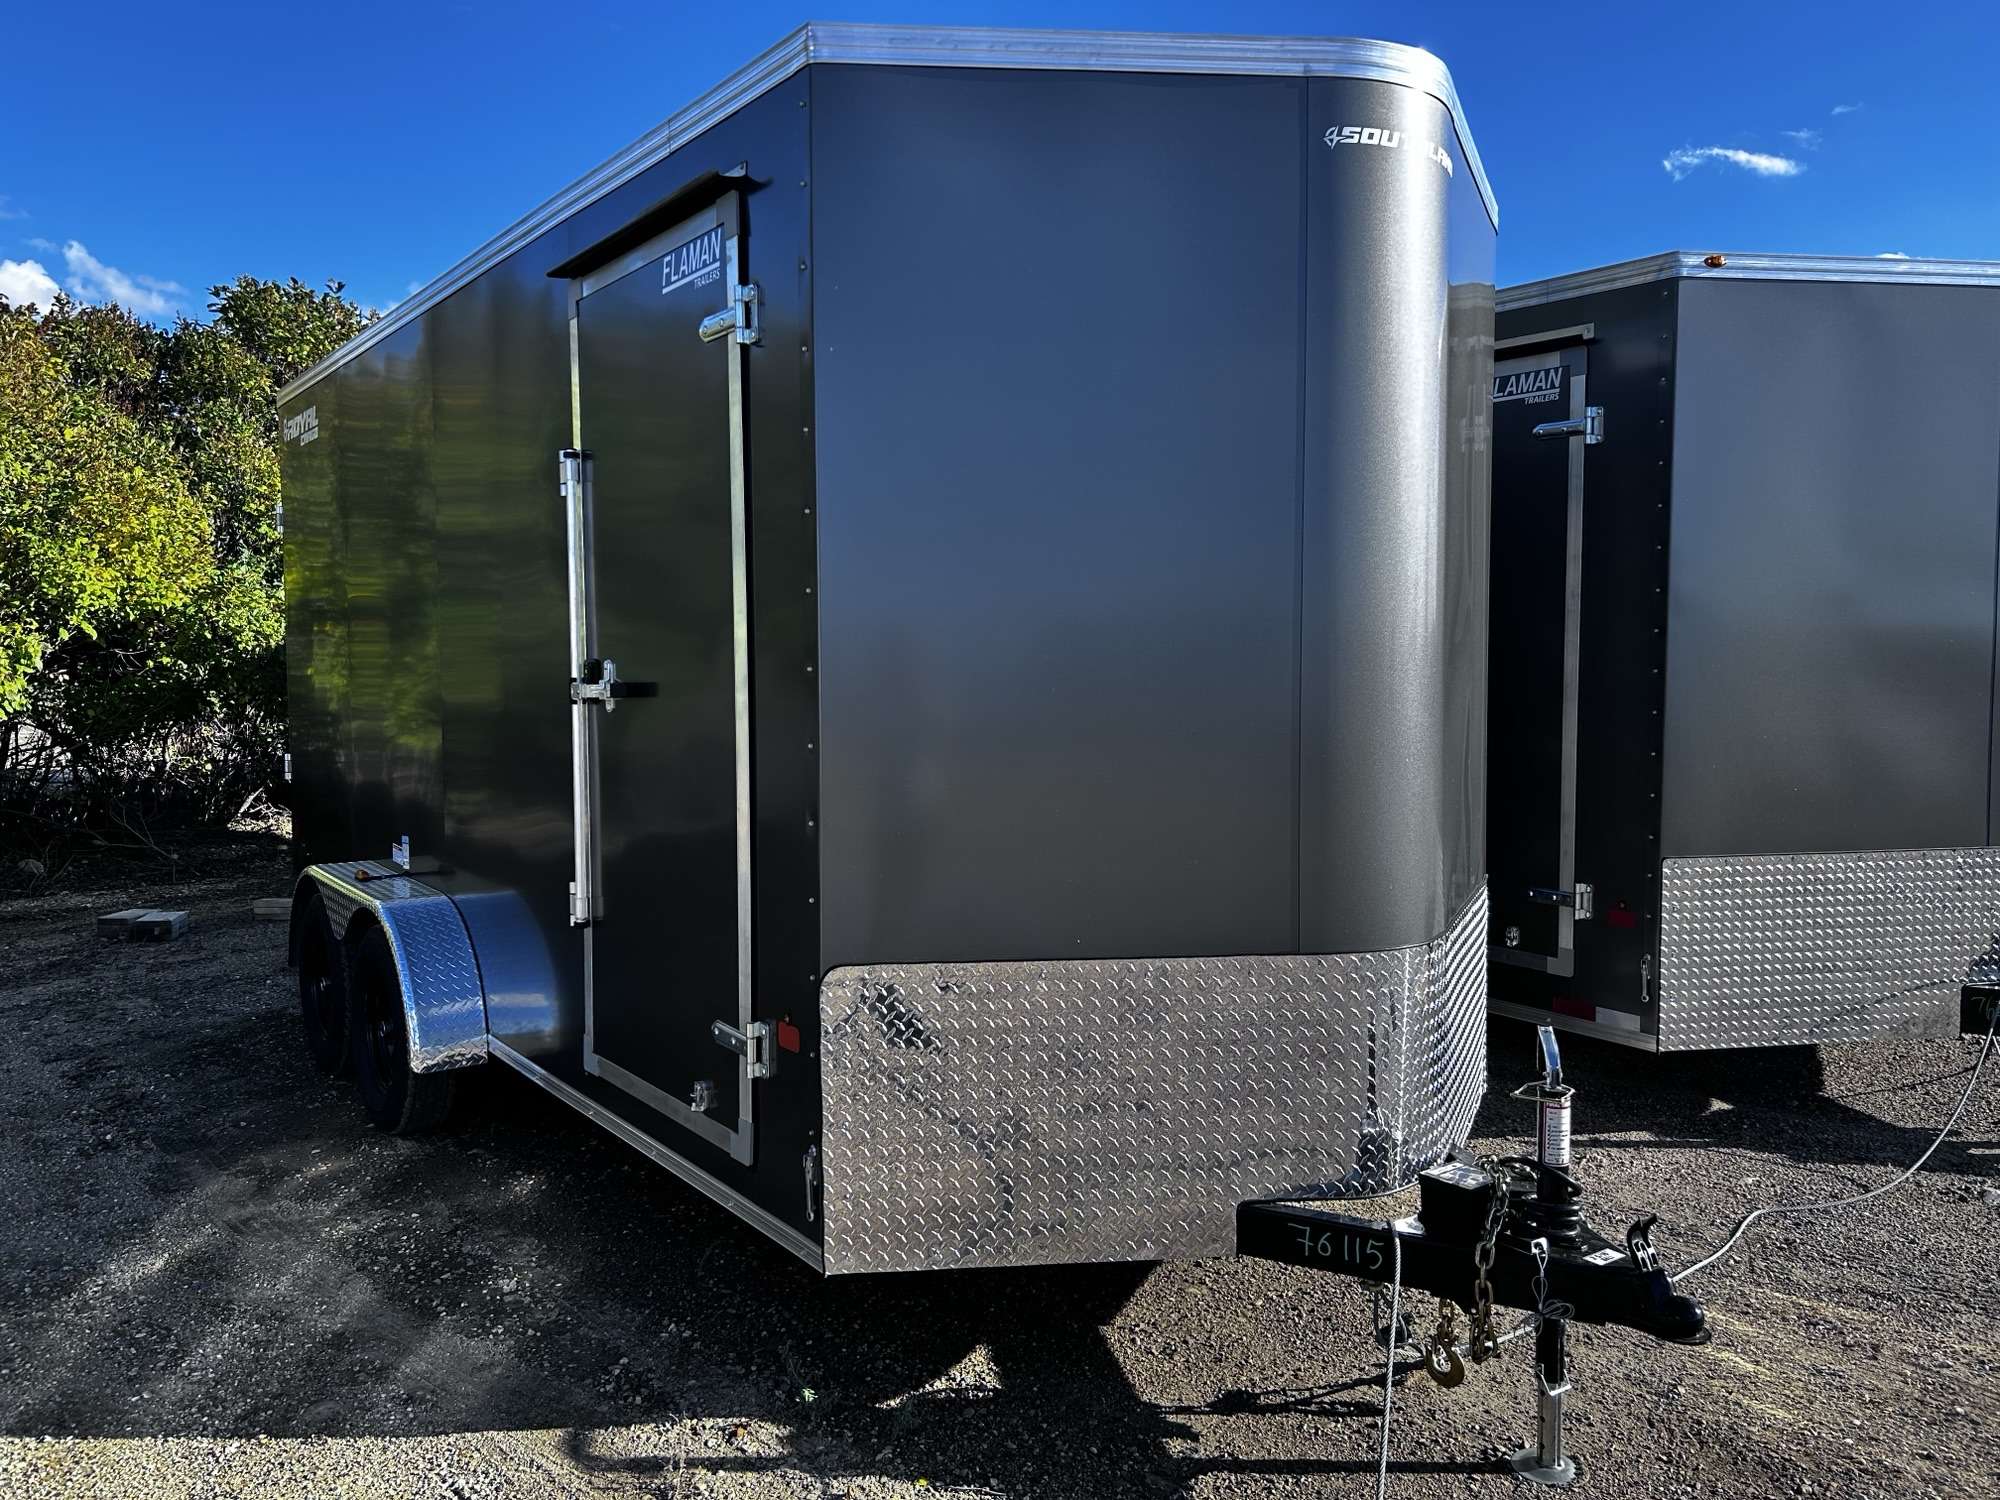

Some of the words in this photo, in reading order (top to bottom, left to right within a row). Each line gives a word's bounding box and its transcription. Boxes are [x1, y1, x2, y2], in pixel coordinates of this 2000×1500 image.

[662, 228, 722, 287] FLAMAN
[694, 267, 721, 289] TRAILERS
[1492, 367, 1563, 397] LAMAN
[1524, 392, 1560, 405] TRAILERS
[1288, 1222, 1385, 1270] 76115
